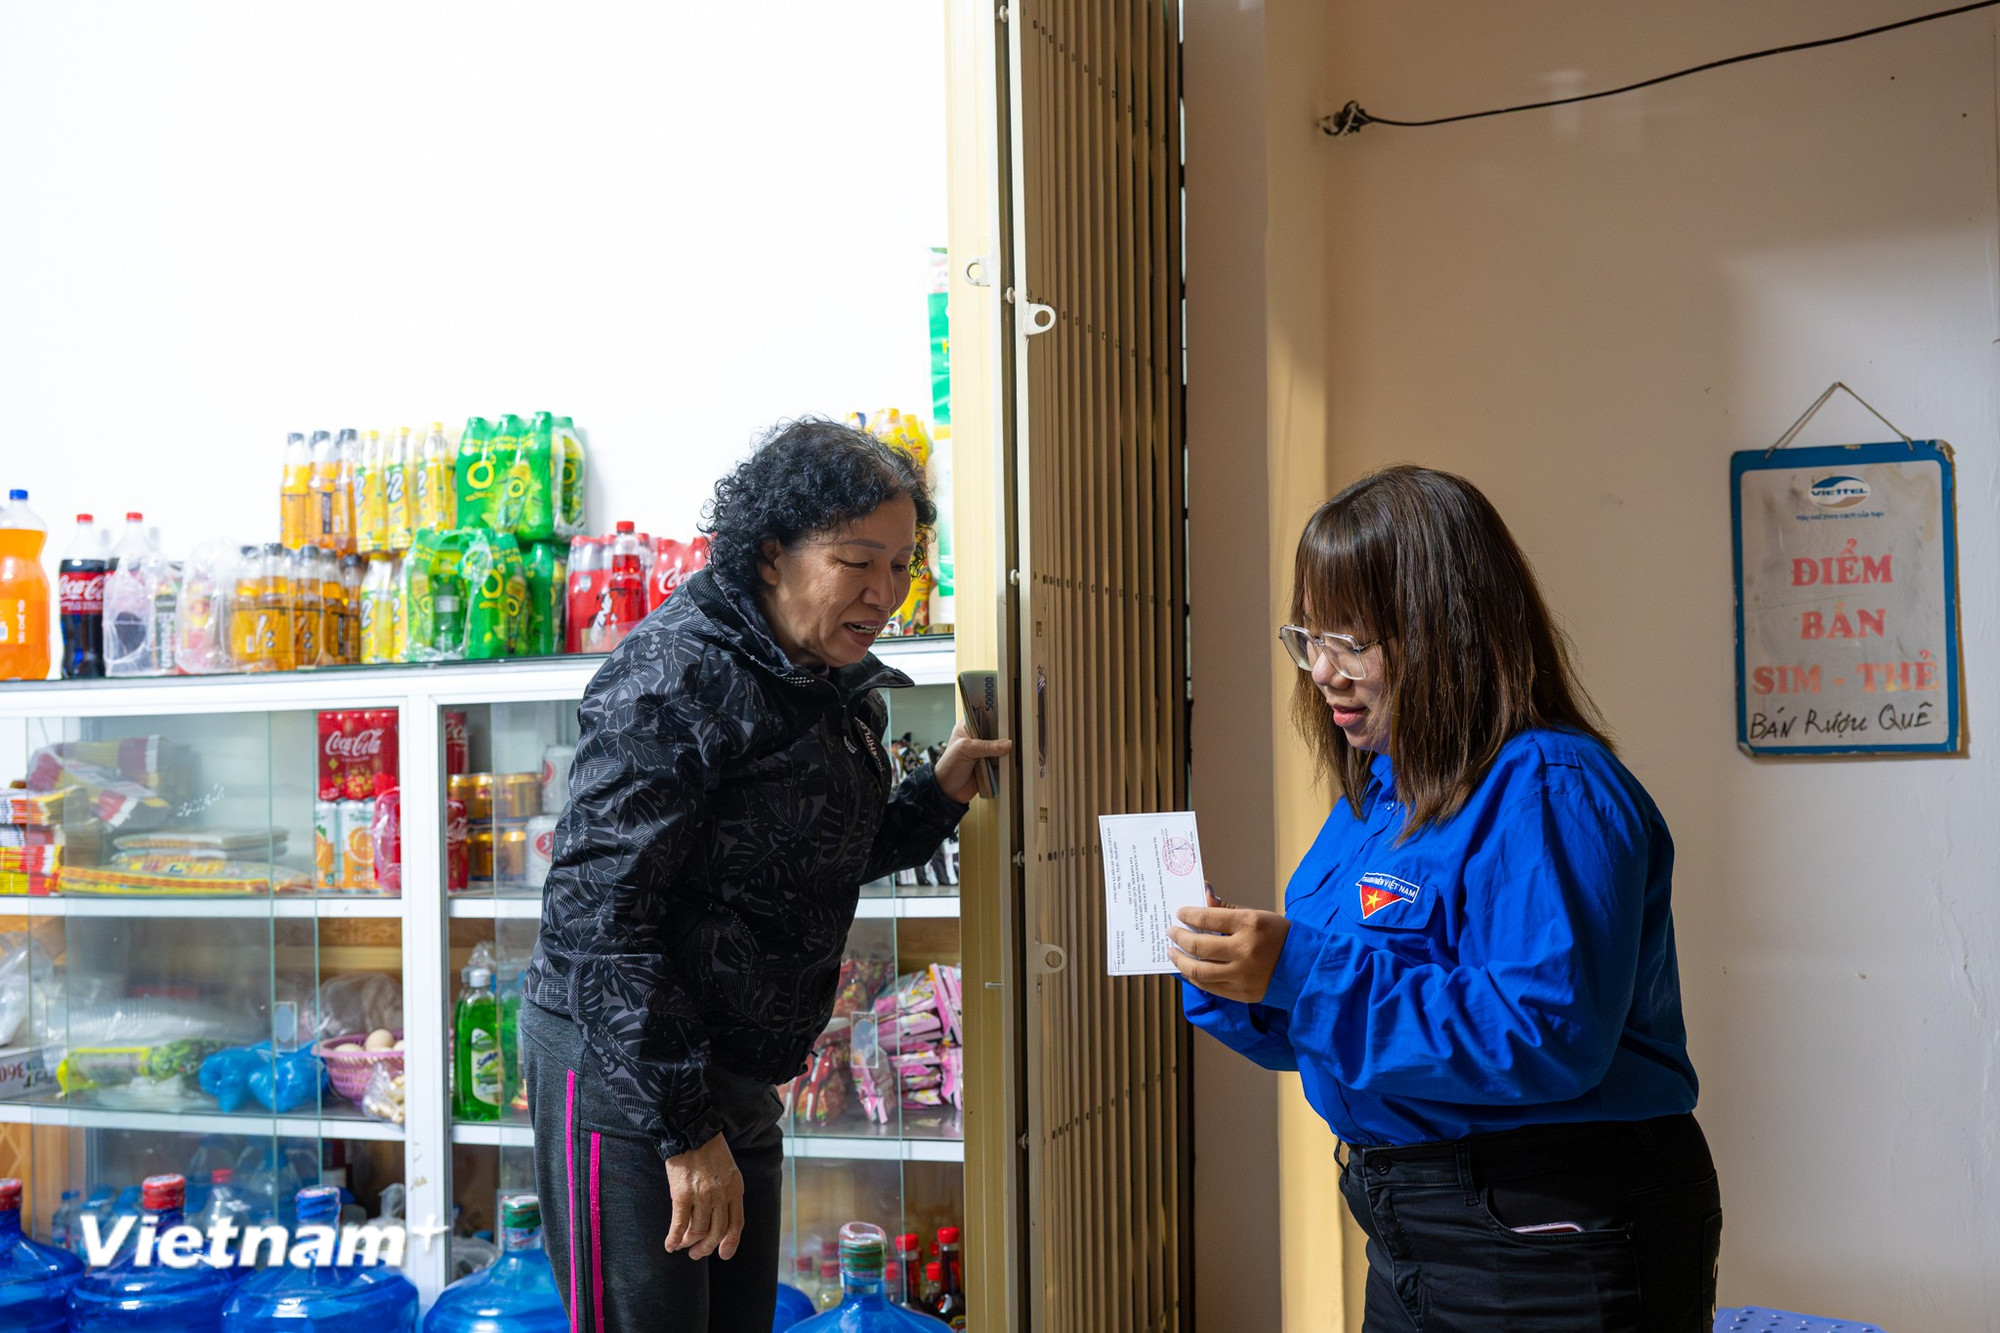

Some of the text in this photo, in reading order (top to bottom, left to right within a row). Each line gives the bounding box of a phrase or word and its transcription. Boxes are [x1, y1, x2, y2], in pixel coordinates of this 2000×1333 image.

[1791, 538, 1893, 587] ĐIỂM
[1800, 602, 1886, 640] BÁN
[1753, 663, 1822, 695] SIM
[1856, 650, 1940, 693] THẺ
[1750, 706, 1798, 739] BÁN
[1879, 701, 1933, 731] QUÊ
[1384, 879, 1400, 891] VIỆT
[1398, 885, 1416, 898] NAM
